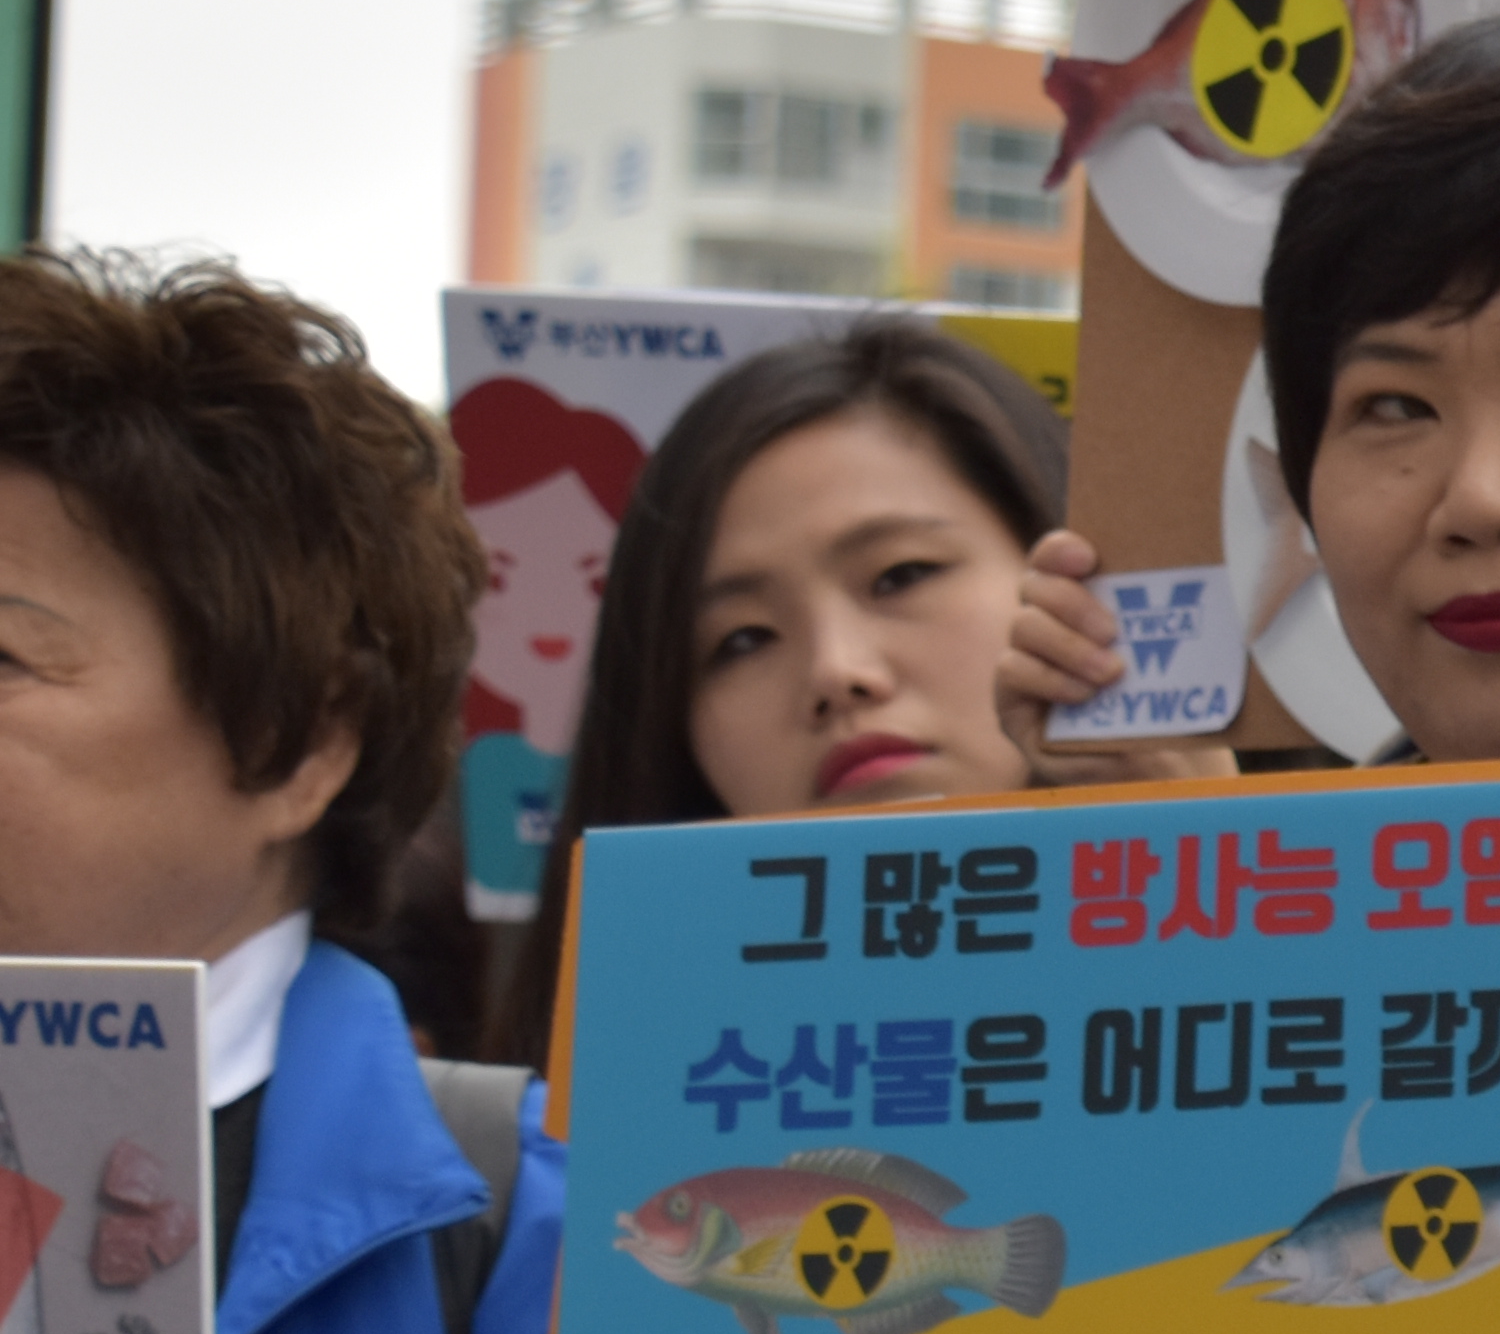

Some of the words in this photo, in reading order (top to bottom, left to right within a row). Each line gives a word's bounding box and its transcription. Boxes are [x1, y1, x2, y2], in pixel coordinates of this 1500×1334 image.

[1065, 685, 1229, 728] 산YWCA
[740, 855, 829, 964] 그
[862, 845, 1040, 960] 많은
[1069, 827, 1340, 949] 방사능
[683, 1013, 1049, 1133] 수산물은
[1083, 997, 1347, 1115] 어디로
